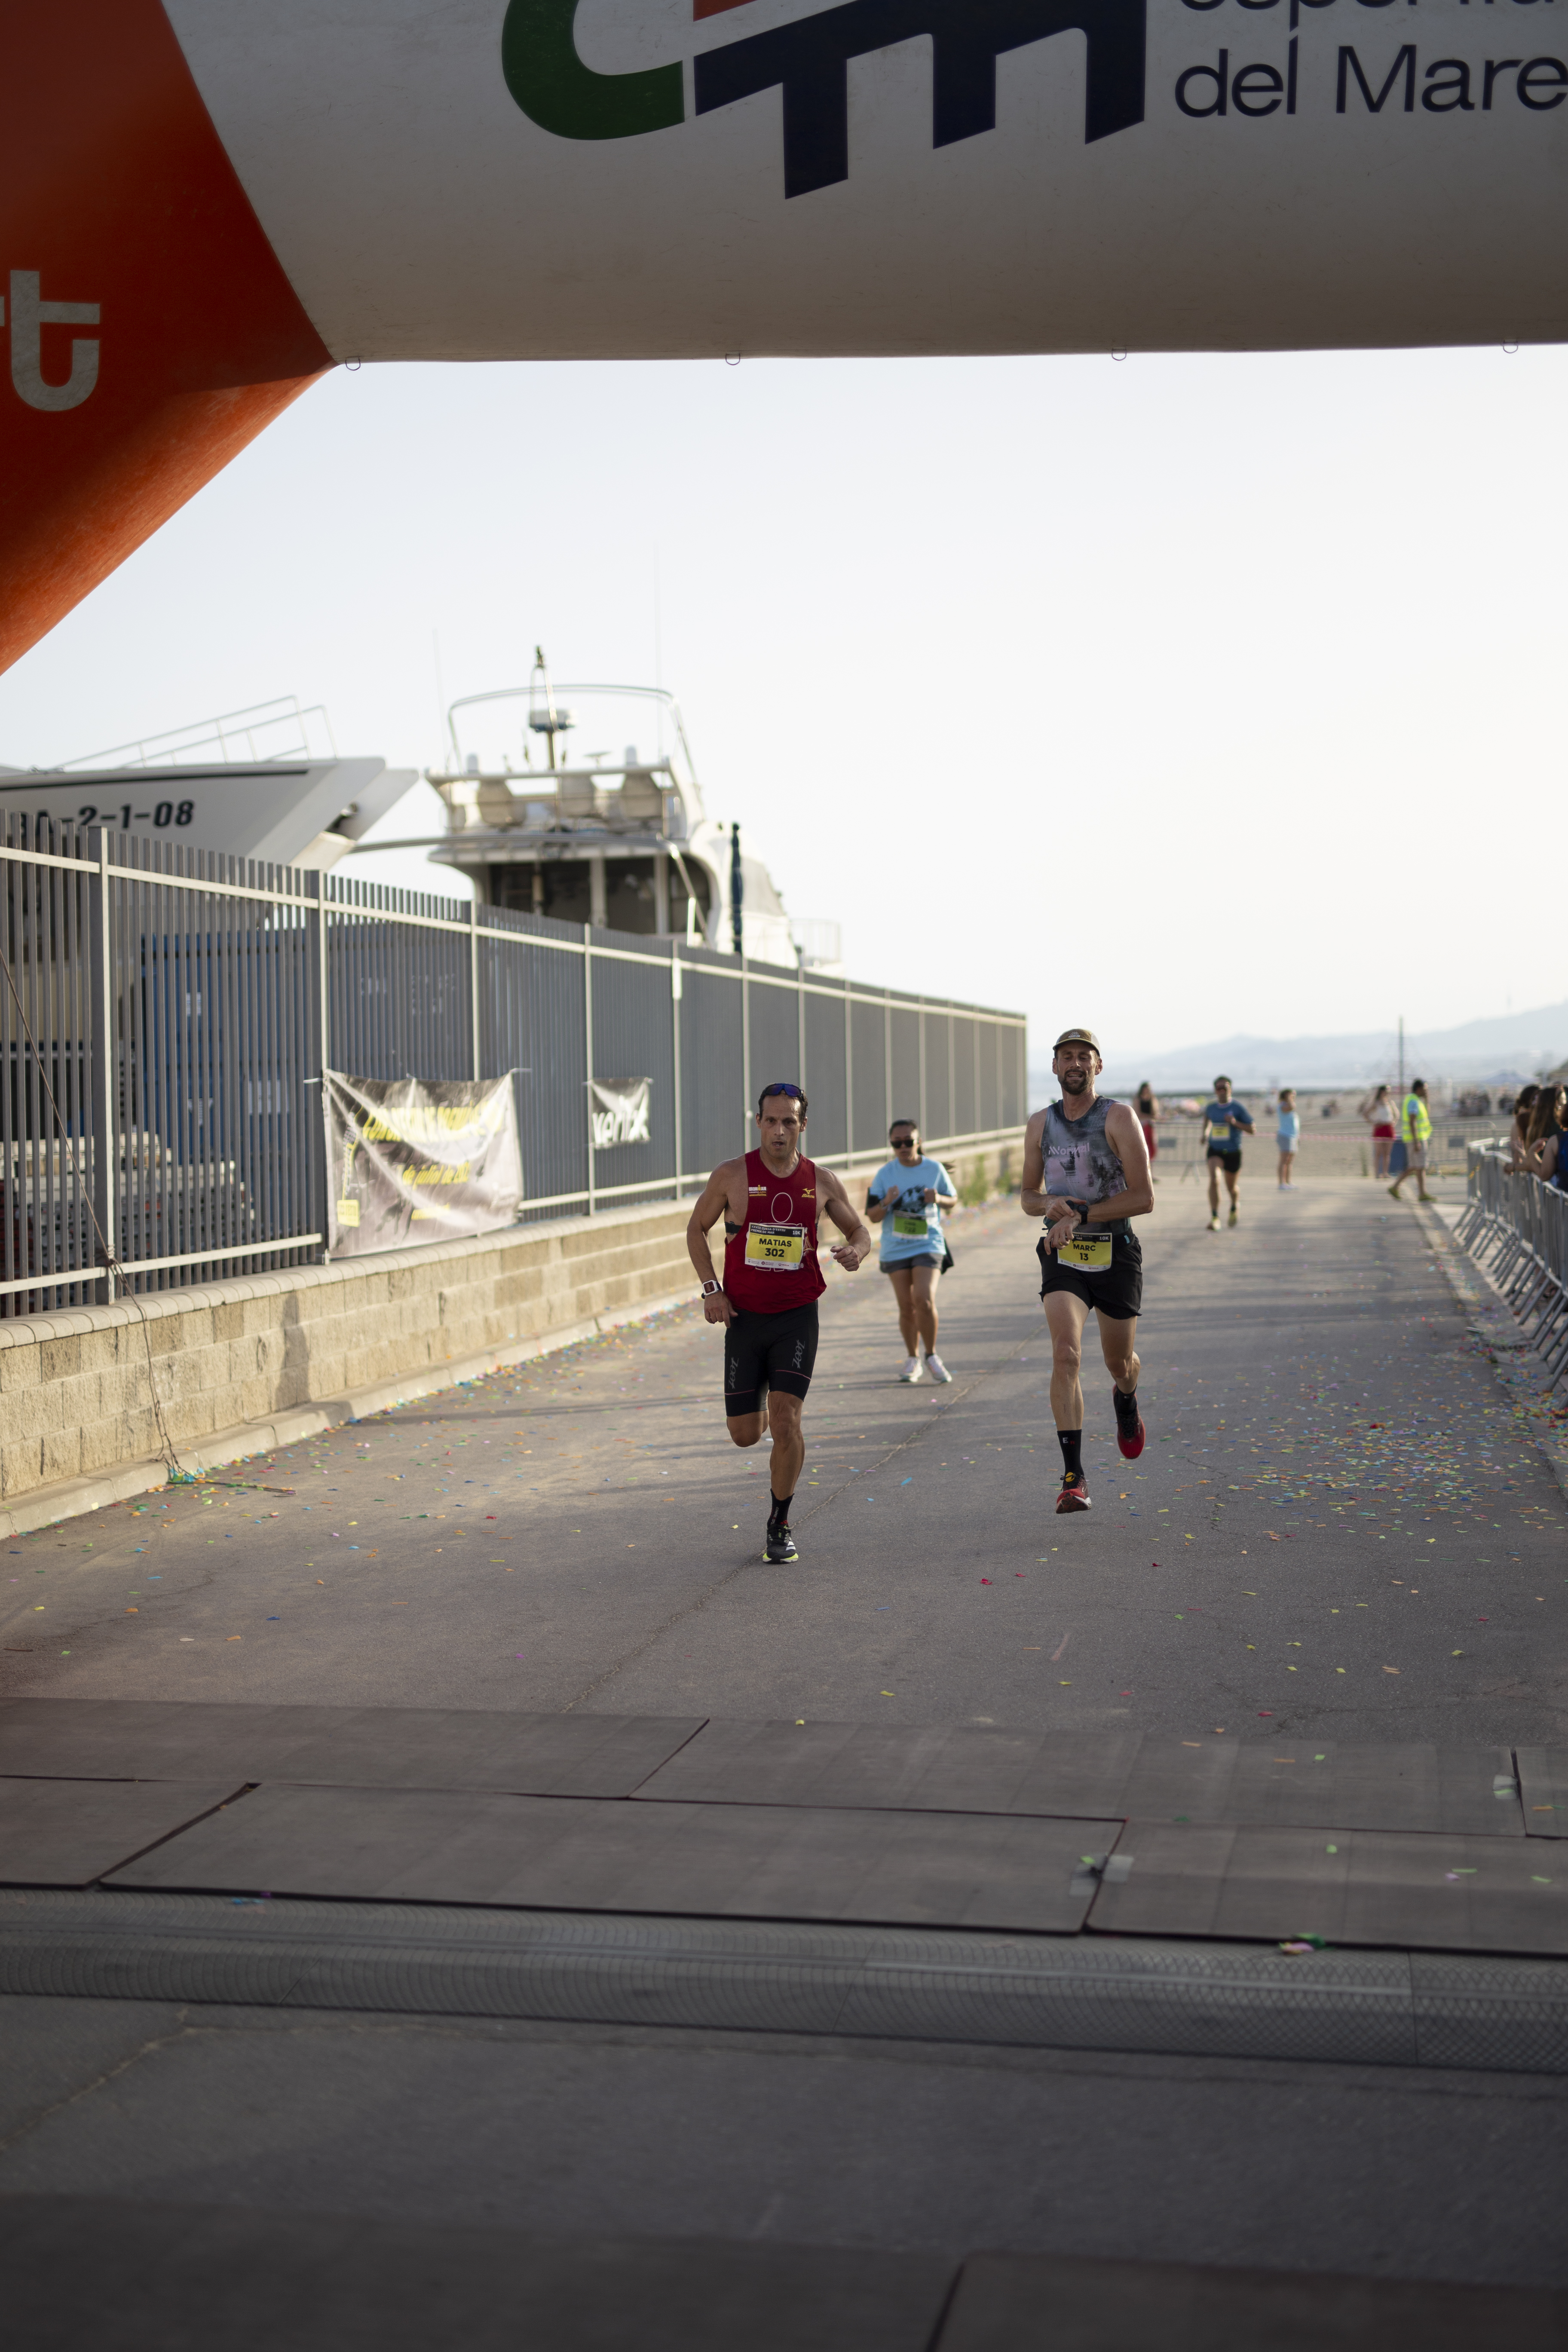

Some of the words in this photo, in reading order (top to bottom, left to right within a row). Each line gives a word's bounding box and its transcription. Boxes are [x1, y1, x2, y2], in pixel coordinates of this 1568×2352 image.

[1175, 35, 1298, 118] del
[759, 1238, 792, 1247] MATIAS
[765, 1248, 784, 1257] 302
[1080, 1253, 1088, 1261] 13
